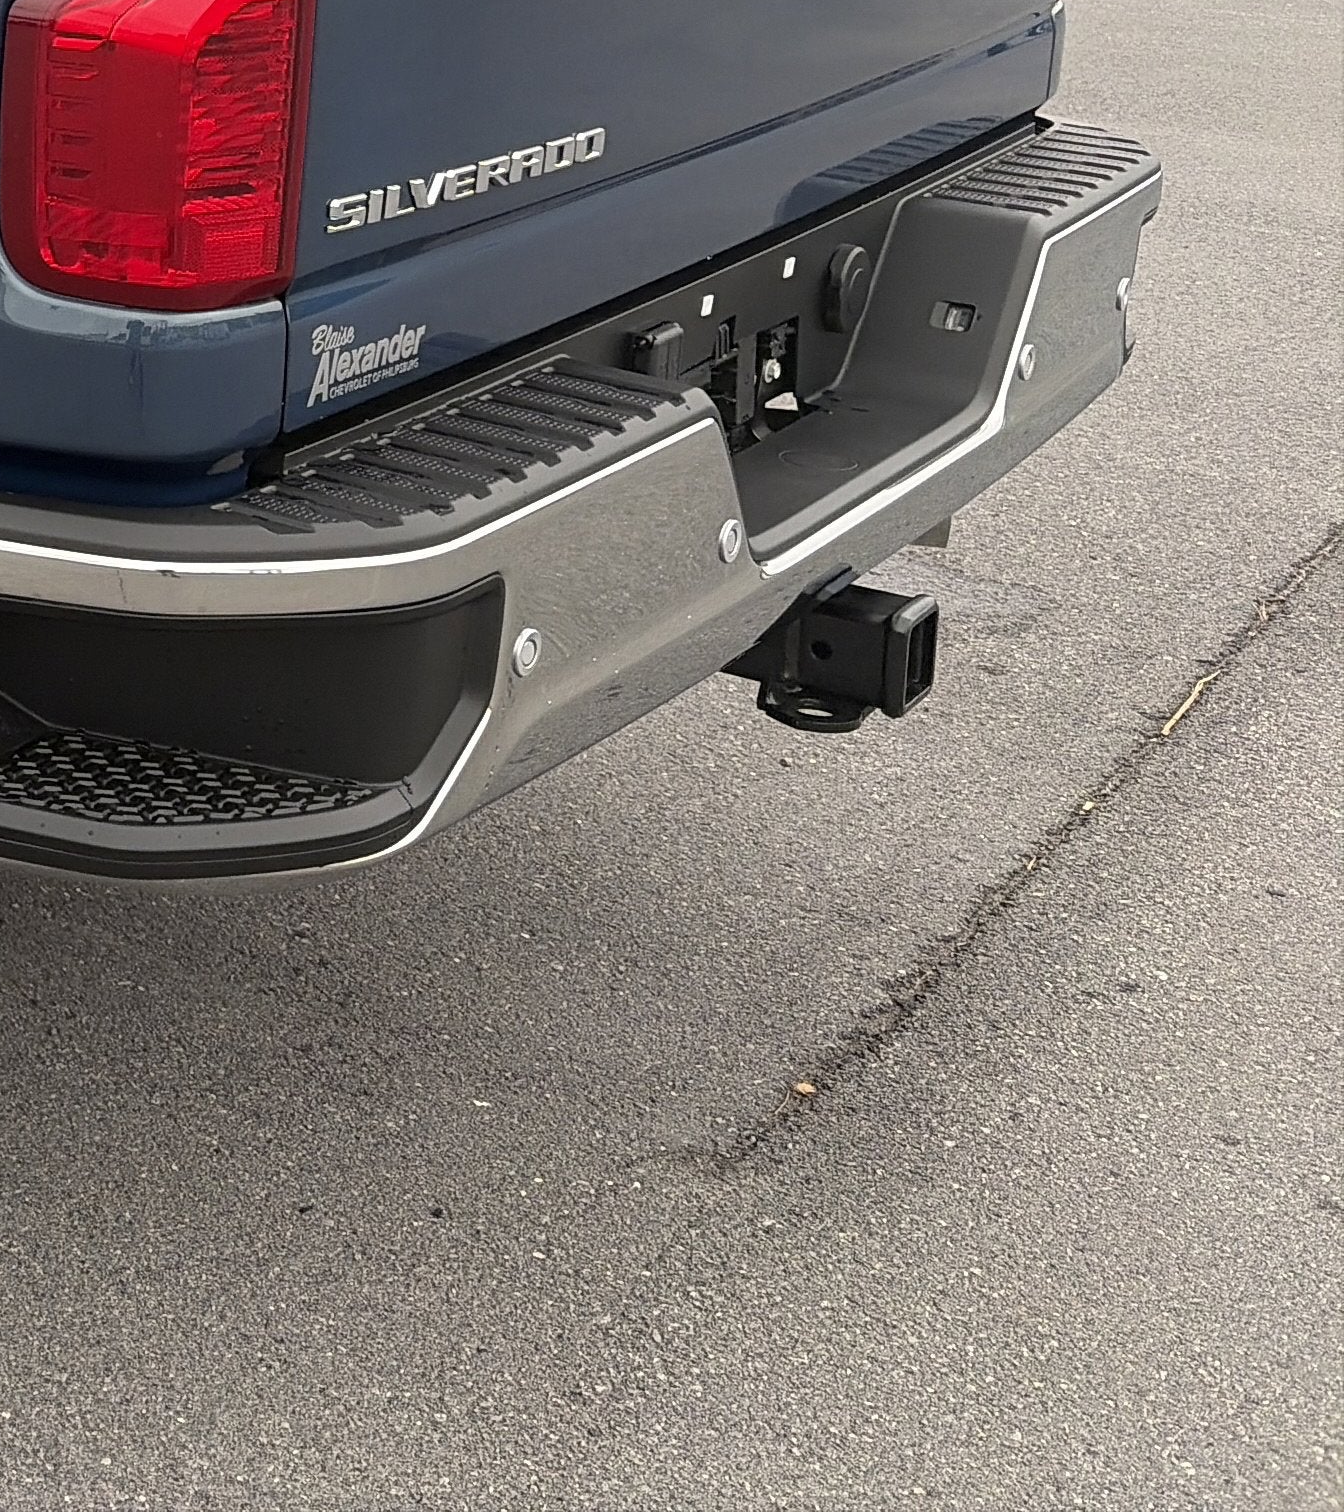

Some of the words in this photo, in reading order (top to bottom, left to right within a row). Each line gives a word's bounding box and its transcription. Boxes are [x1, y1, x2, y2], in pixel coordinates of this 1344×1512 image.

[325, 127, 606, 233] SILVERADO
[306, 324, 427, 408] Alexander
[311, 324, 355, 356] Blaise
[329, 373, 373, 399] CHEVROLET
